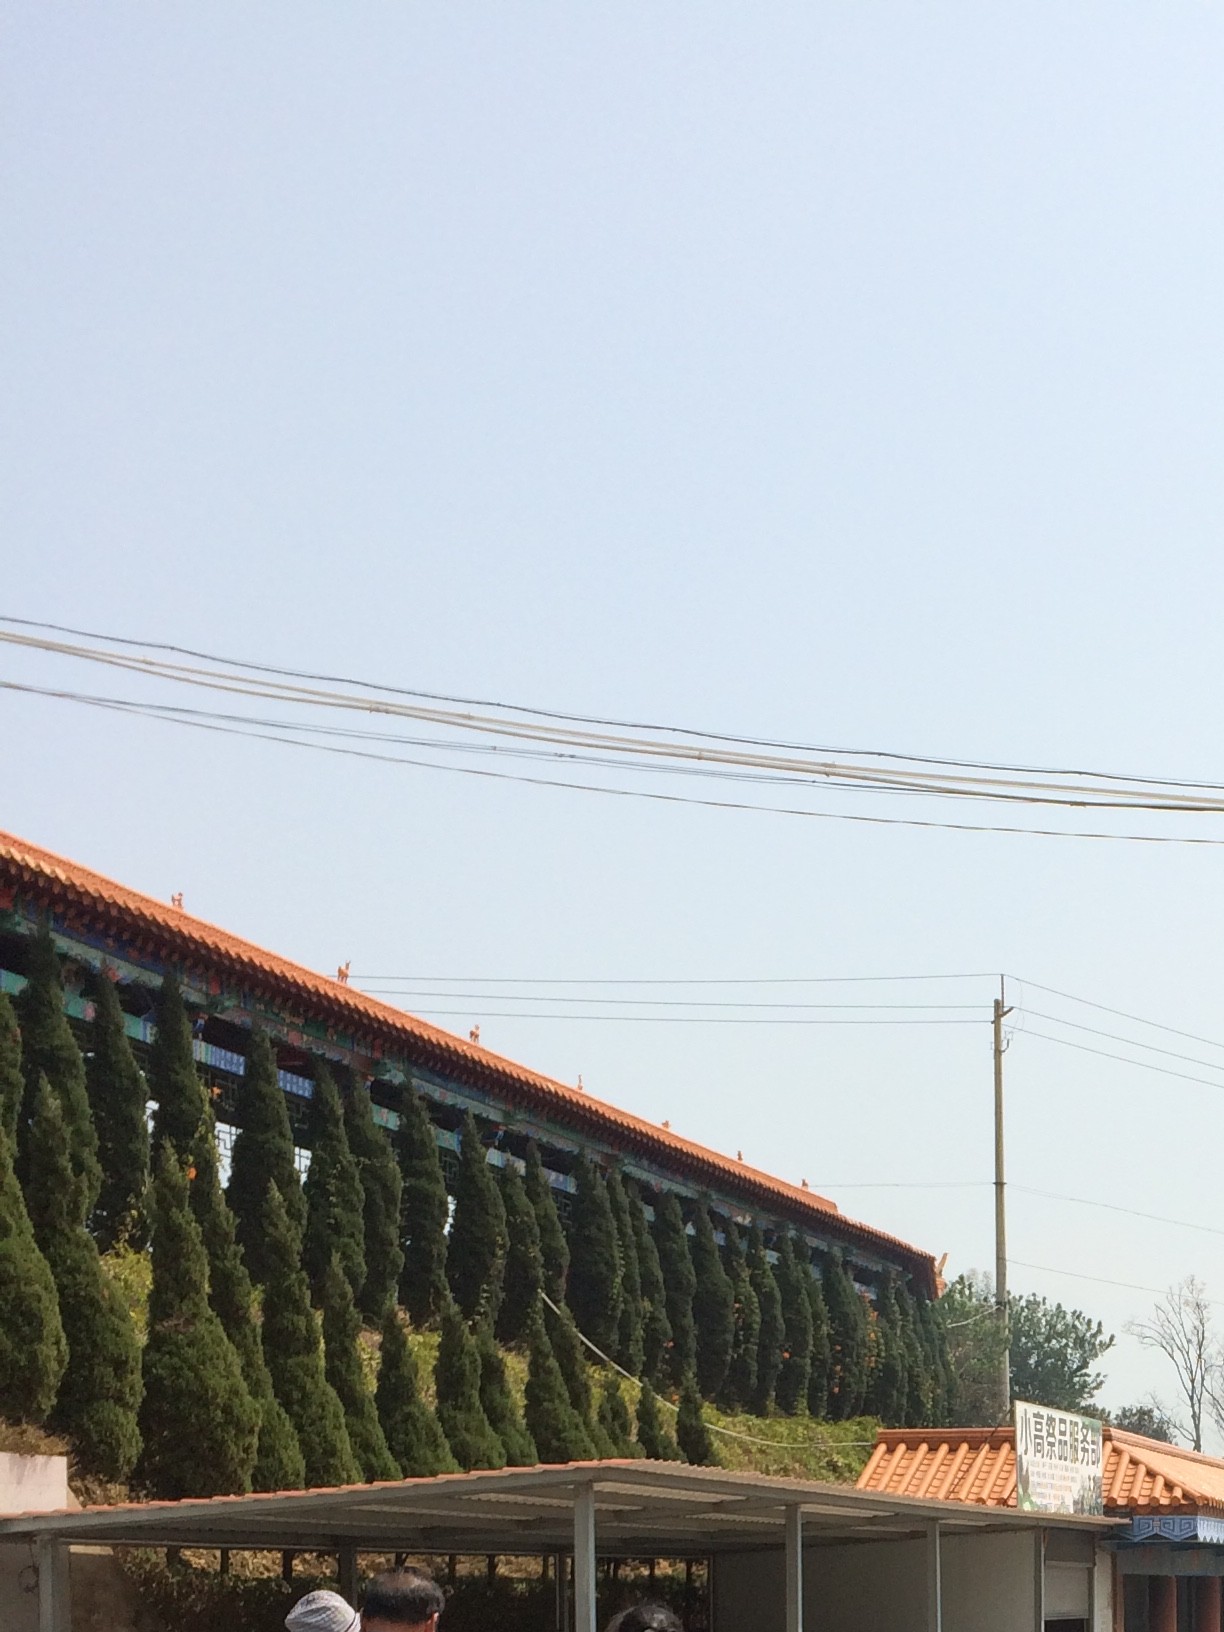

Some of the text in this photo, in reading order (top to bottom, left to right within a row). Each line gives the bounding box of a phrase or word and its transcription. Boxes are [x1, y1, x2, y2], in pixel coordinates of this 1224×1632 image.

[1020, 1408, 1101, 1468] 小高祭品服务部
